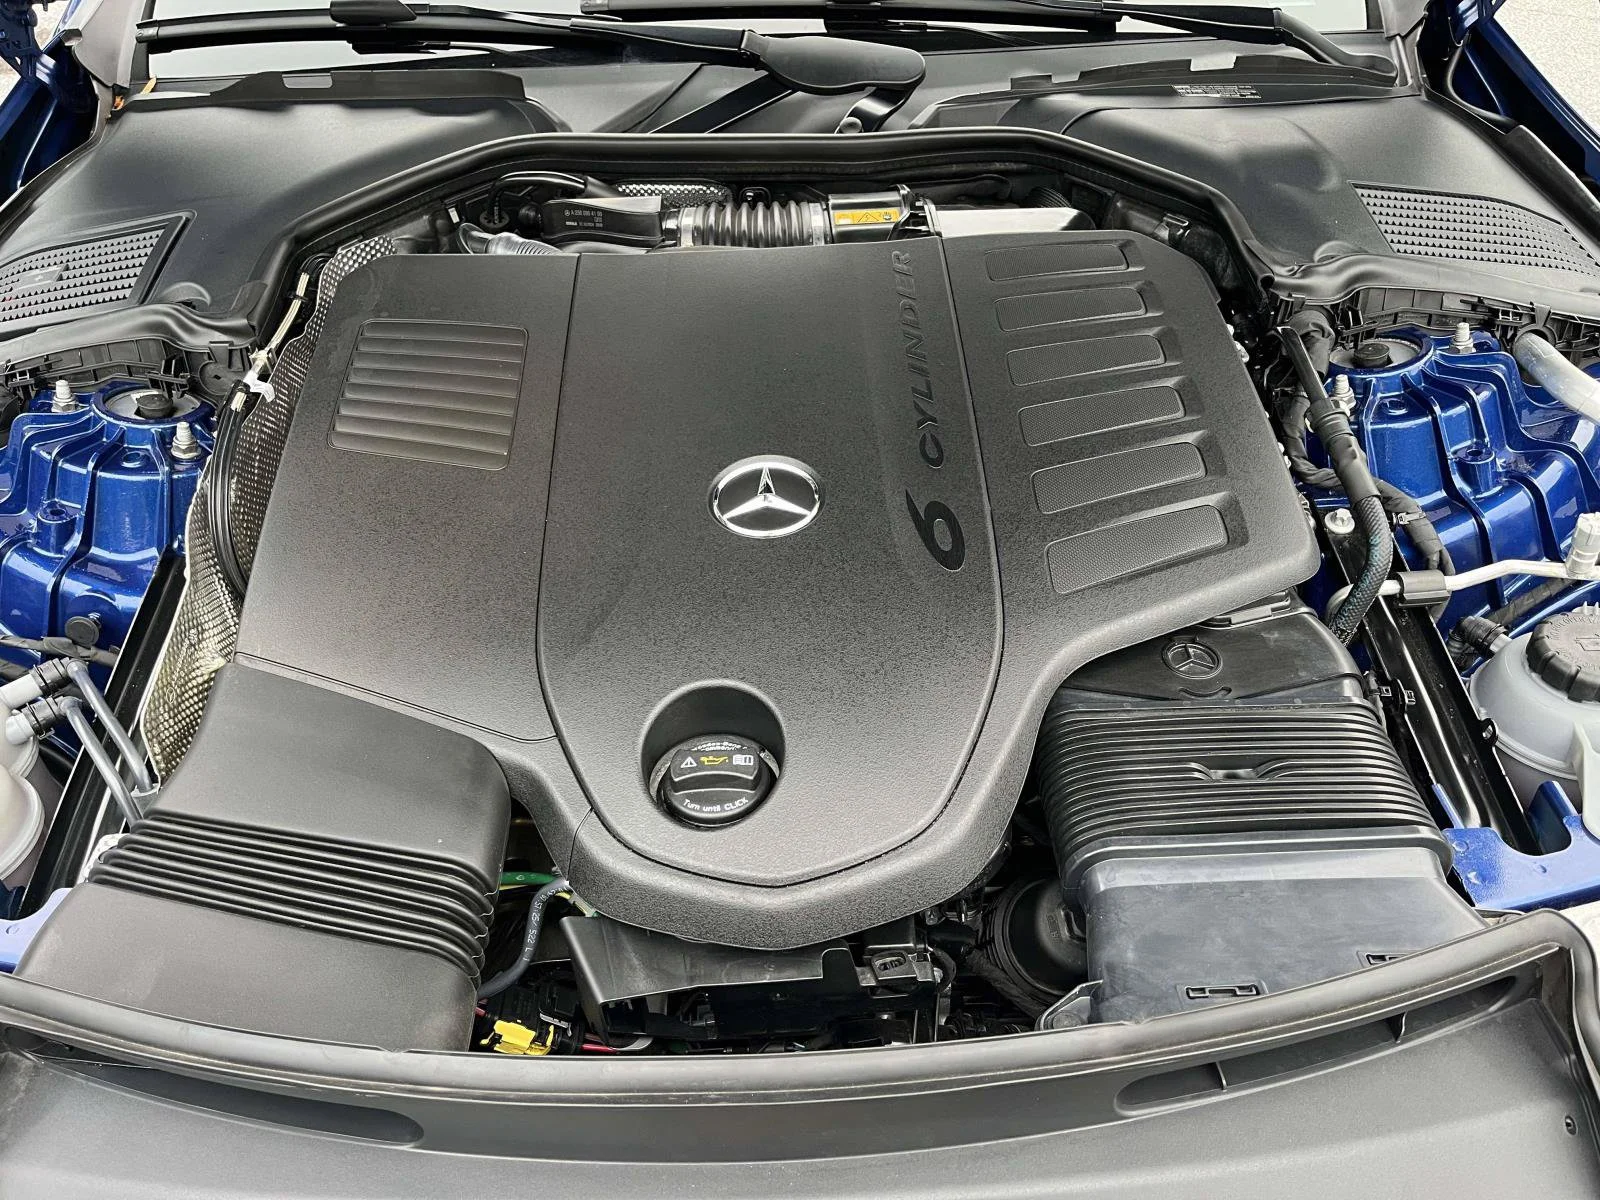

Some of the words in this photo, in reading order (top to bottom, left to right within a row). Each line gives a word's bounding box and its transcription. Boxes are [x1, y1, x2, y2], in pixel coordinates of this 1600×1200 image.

[891, 249, 944, 469] CYLINDER
[905, 488, 966, 572] 6
[683, 799, 700, 811] Turn
[702, 804, 721, 812] until
[724, 797, 749, 811] CLICK
